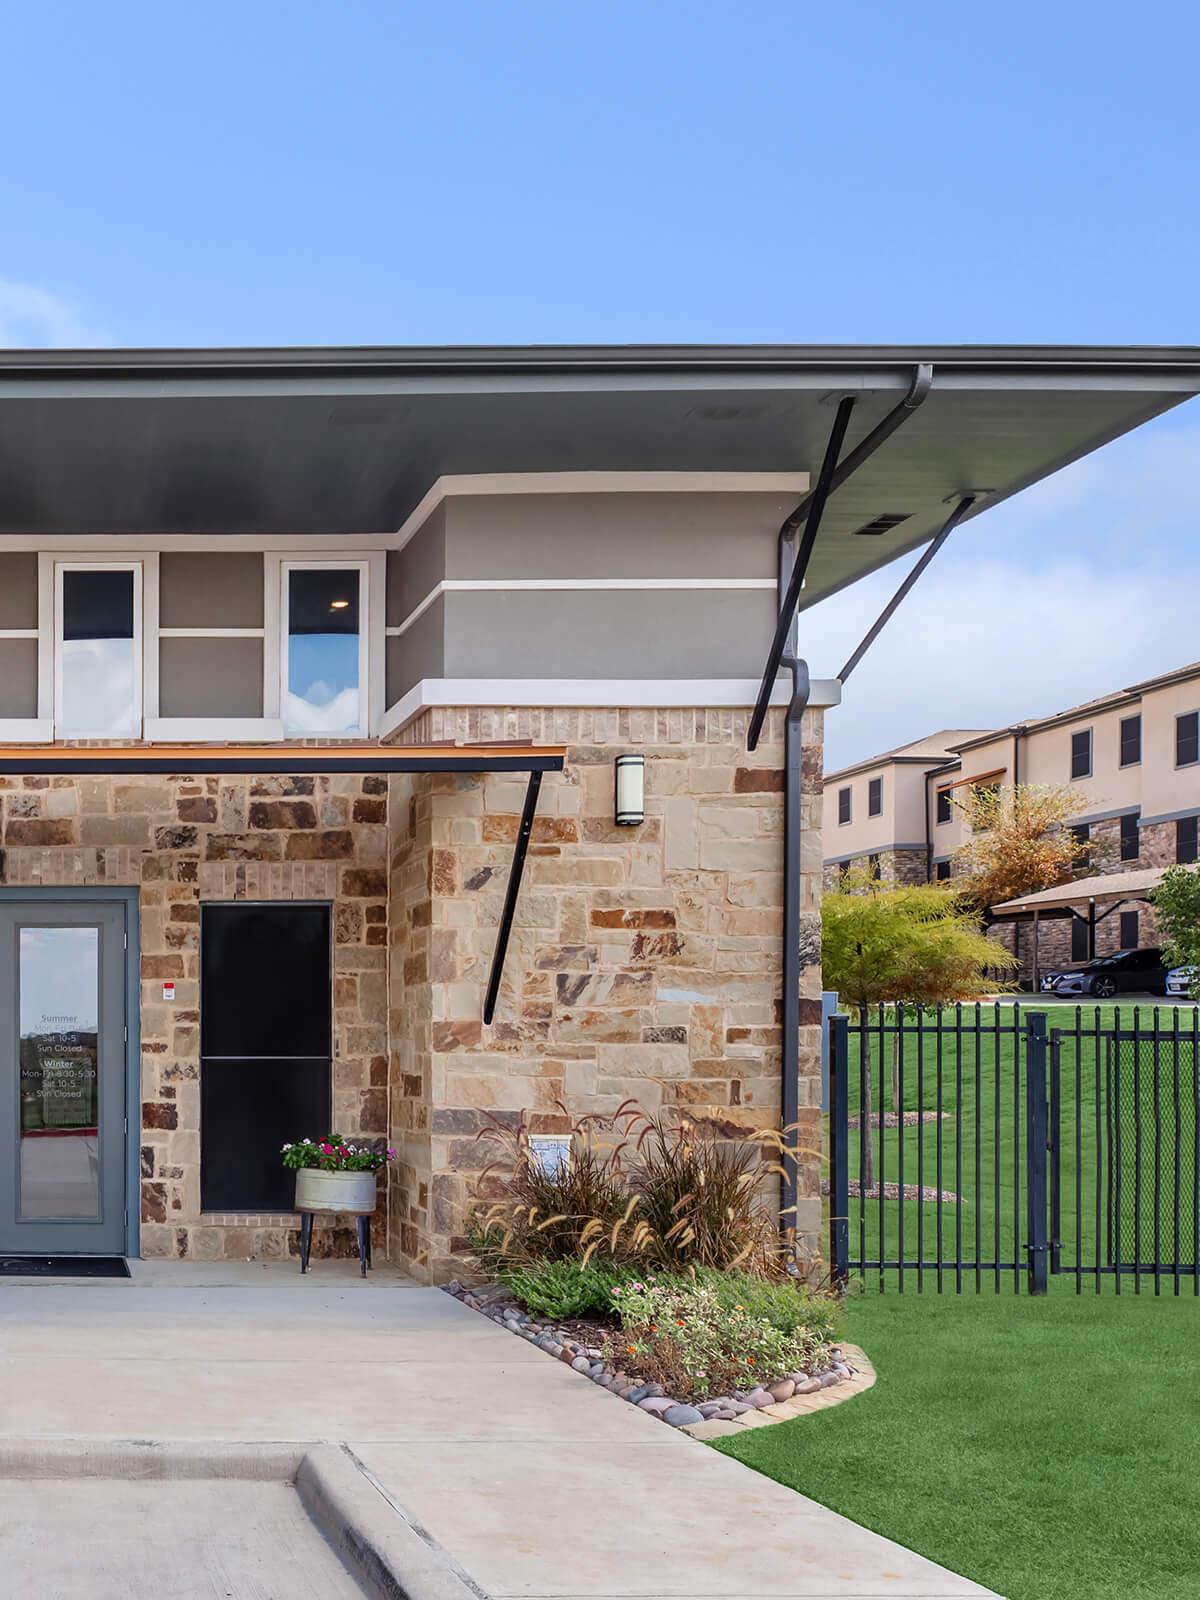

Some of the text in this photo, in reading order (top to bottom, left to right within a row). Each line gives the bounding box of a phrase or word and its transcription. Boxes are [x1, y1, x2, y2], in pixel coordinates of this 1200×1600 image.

[41, 1014, 78, 1024] Summer
[43, 1034, 77, 1042] Sat 10-5
[37, 1044, 82, 1053] Sun Closed
[43, 1060, 73, 1069] Winter
[42, 1080, 56, 1088] Sat
[36, 1090, 82, 1098] Sun Closed
